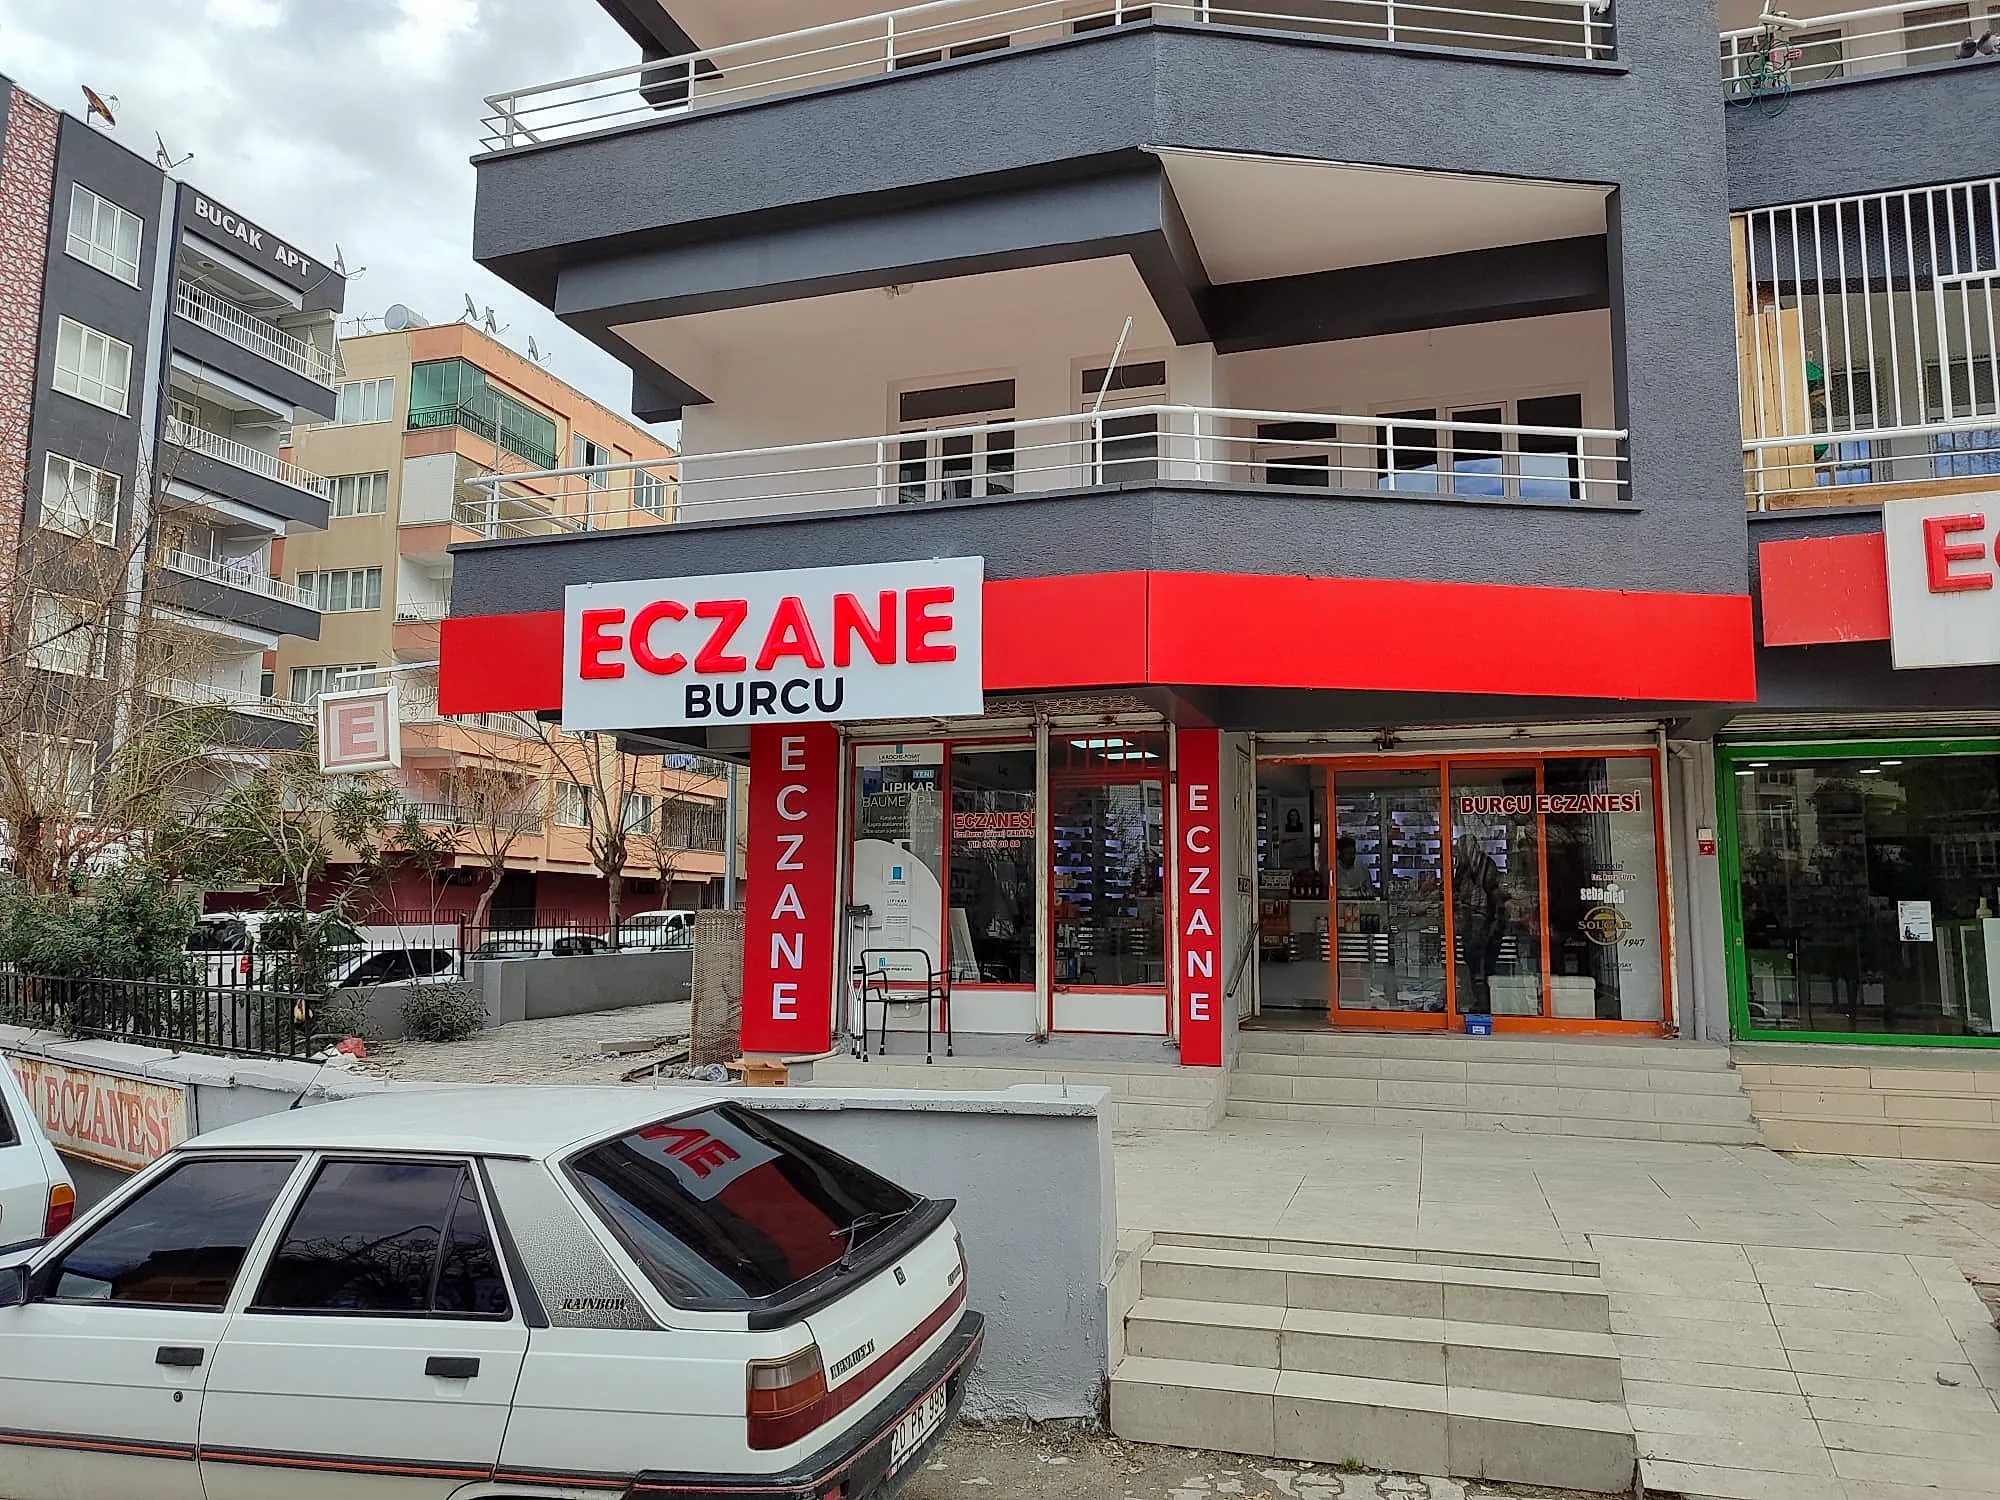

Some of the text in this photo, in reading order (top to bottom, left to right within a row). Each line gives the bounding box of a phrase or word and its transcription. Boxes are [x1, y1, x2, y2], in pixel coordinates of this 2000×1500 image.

[195, 197, 311, 276] BUCAK APT
[1923, 513, 2000, 593] E
[579, 586, 957, 680] ECZANE
[684, 677, 844, 718] BURCU
[862, 795, 905, 808] BAUME
[882, 781, 935, 793] LIPIKAR
[1460, 791, 1641, 815] BURCU ECZANESİ
[770, 736, 808, 1020] ECZANE
[1186, 785, 1213, 1021] ECZANE
[1624, 938, 1646, 948] 1947
[562, 1298, 629, 1310] RAINBOW
[893, 1422, 906, 1457] 20
[911, 1405, 924, 1440] PR
[929, 1385, 945, 1420] 998
